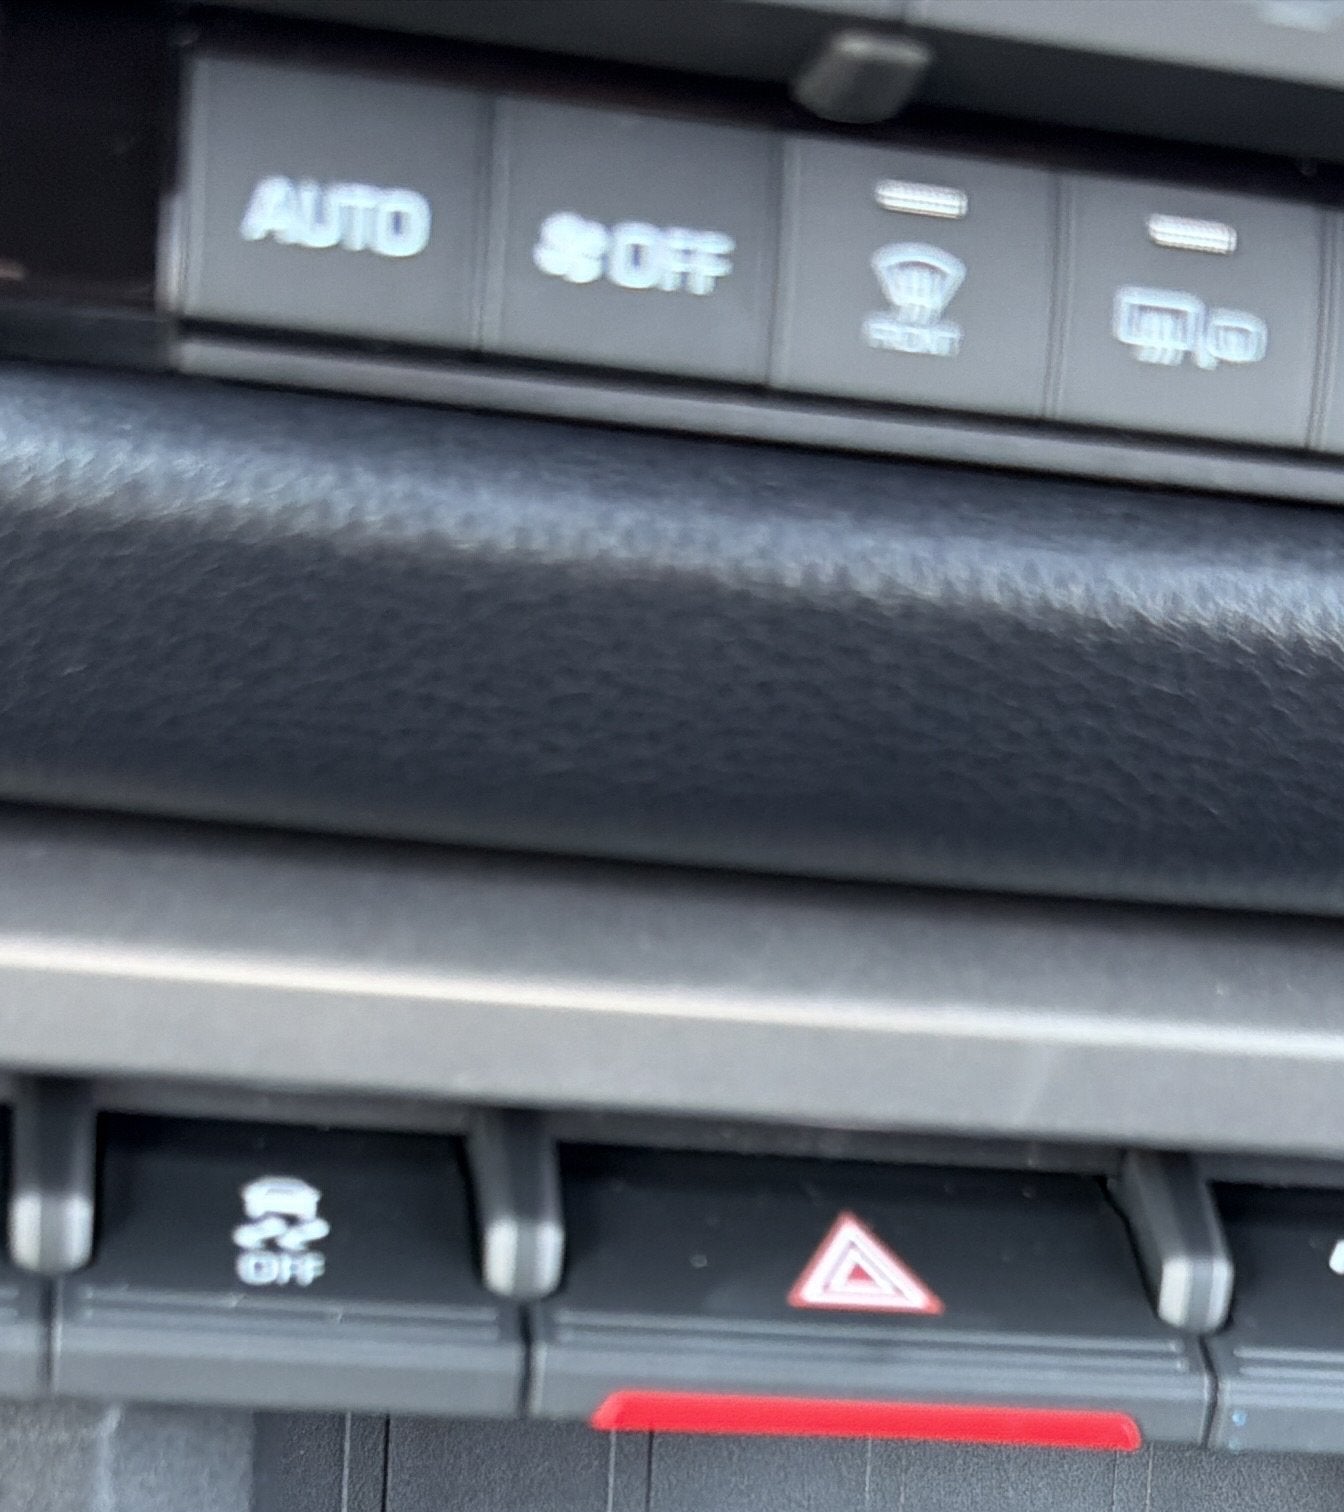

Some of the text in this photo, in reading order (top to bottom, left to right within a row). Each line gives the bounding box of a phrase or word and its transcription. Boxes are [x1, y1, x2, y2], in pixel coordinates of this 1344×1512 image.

[240, 175, 432, 258] AUTO
[607, 221, 736, 296] OFF
[236, 1251, 325, 1286] OFF
